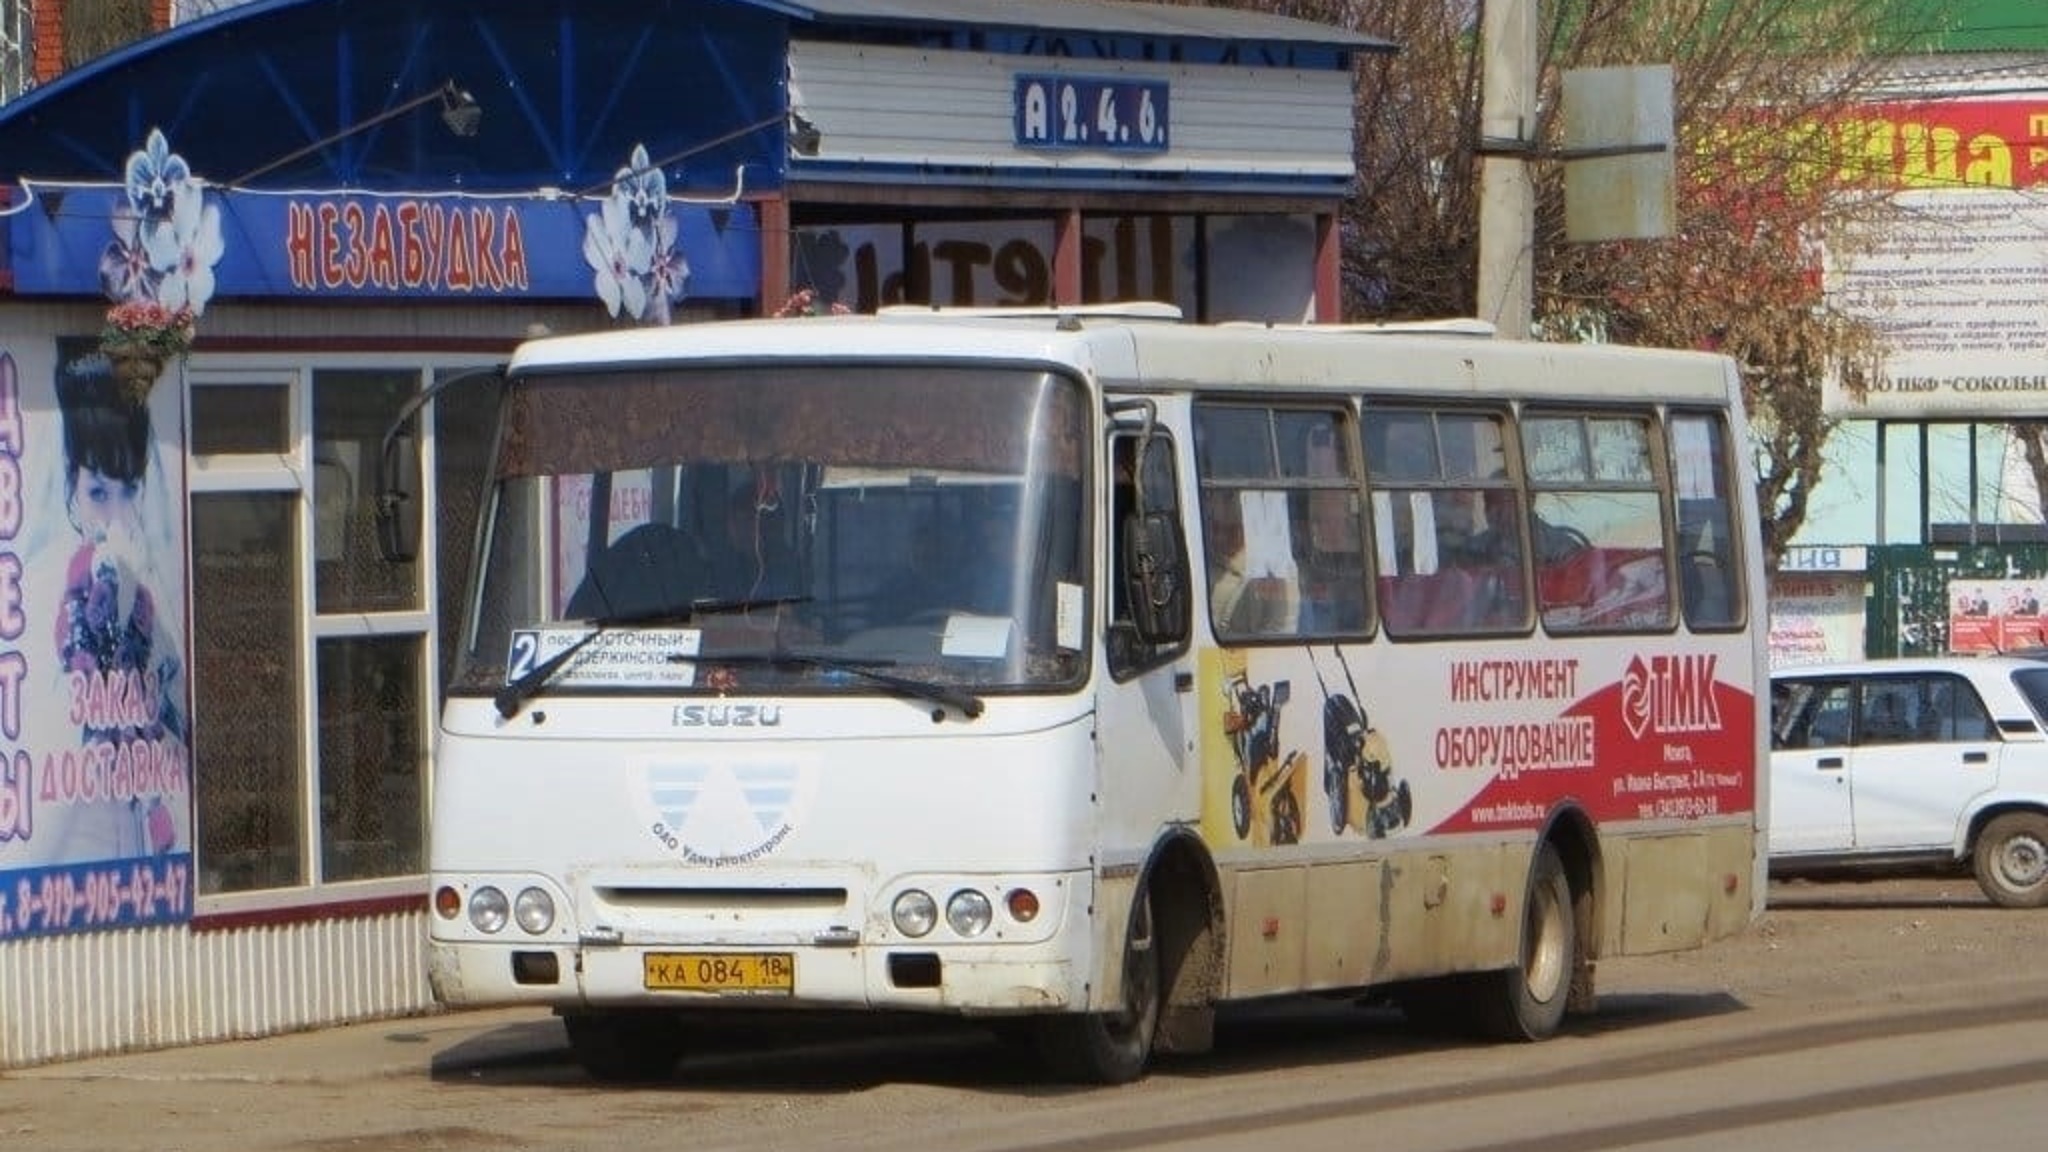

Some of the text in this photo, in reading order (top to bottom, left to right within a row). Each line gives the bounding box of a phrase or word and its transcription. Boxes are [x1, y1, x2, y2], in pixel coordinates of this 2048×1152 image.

[287, 201, 528, 292] НЕЗАБУДКА
[1896, 375, 1939, 394] ПКФ
[511, 633, 537, 681] 2
[1450, 659, 1578, 702] ИНСТРУМЕНТ
[69, 668, 161, 731] ЗАКАЗ
[672, 704, 782, 727] ISUZU
[1650, 654, 1722, 733] ТМК
[39, 740, 185, 803] ДОСТАВКА
[1435, 717, 1594, 780] ОБОРУДОВАНИЕ
[698, 959, 744, 984] 084
[759, 958, 782, 977] 18
